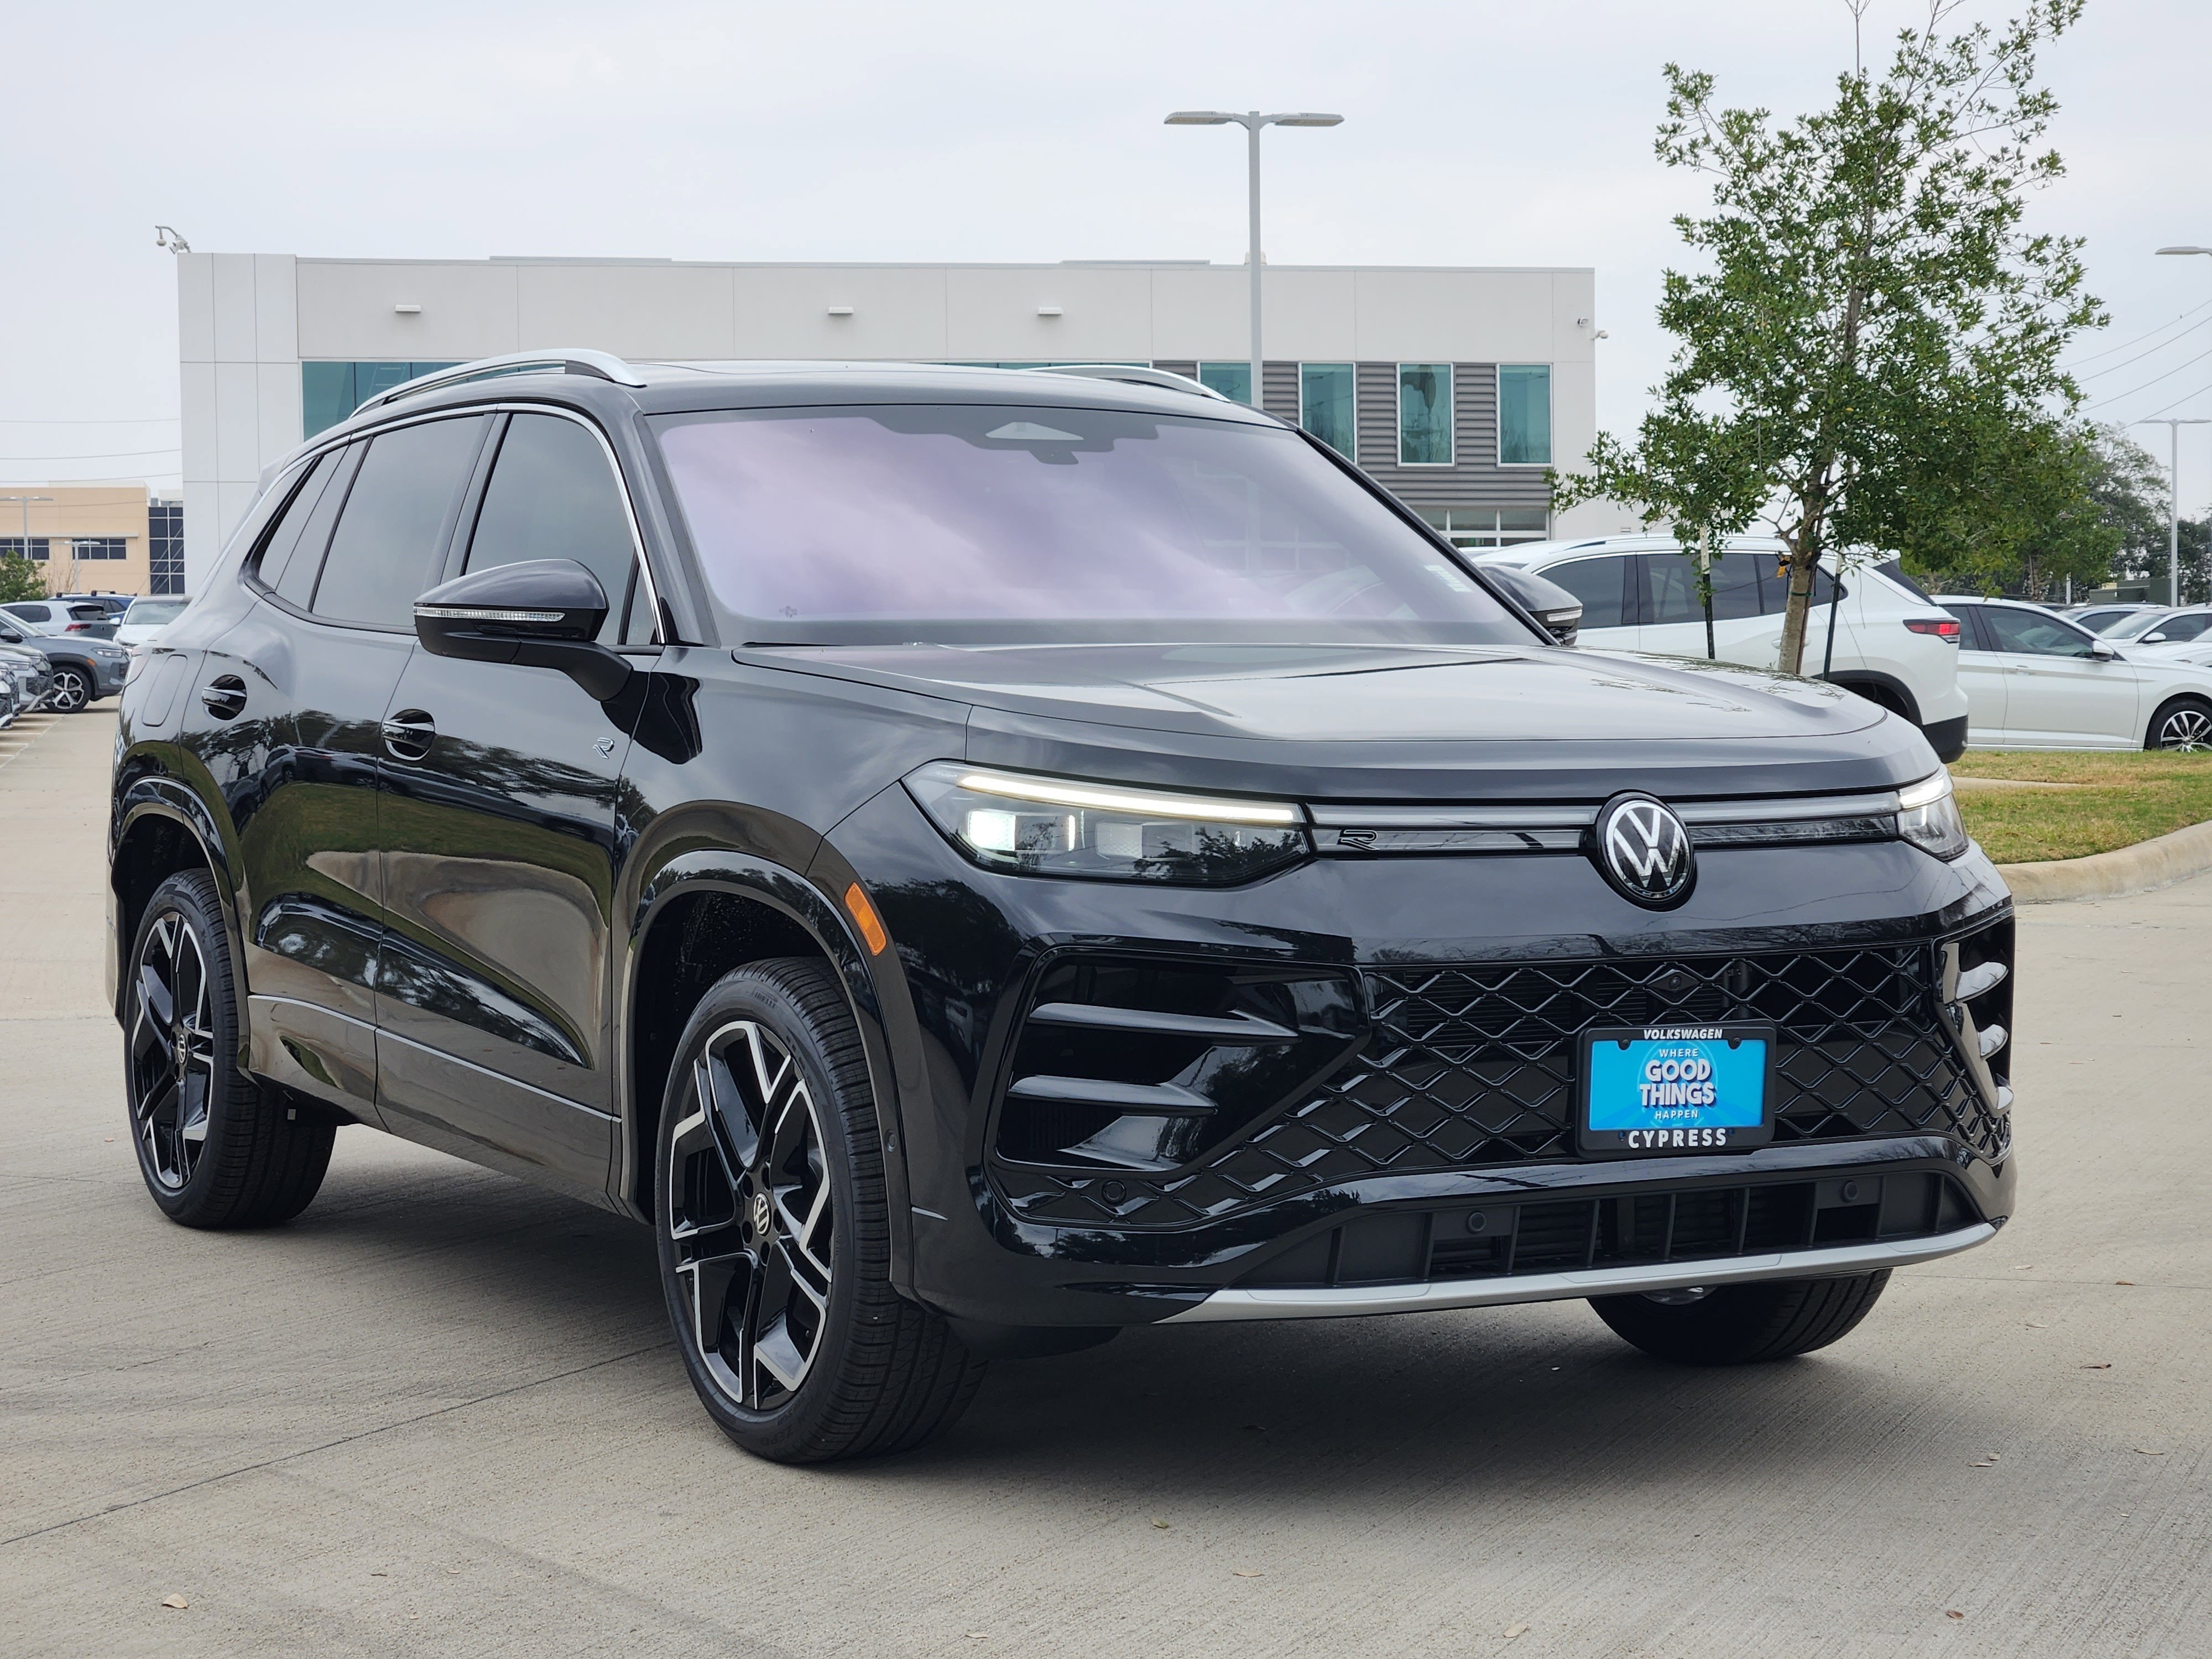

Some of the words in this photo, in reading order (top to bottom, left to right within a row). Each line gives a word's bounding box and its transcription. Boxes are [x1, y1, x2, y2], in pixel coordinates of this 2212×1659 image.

[593, 737, 614, 759] R
[1340, 830, 1380, 851] R
[1606, 801, 1689, 898] VW
[1644, 1029, 1723, 1040] VOLKSWAGEN
[1660, 1048, 1699, 1058] WHERE
[1645, 1058, 1712, 1082] GOOD
[1640, 1082, 1716, 1107] THINGS
[1655, 1110, 1699, 1120] HAPPEN
[1628, 1128, 1726, 1149] CYPRESS
